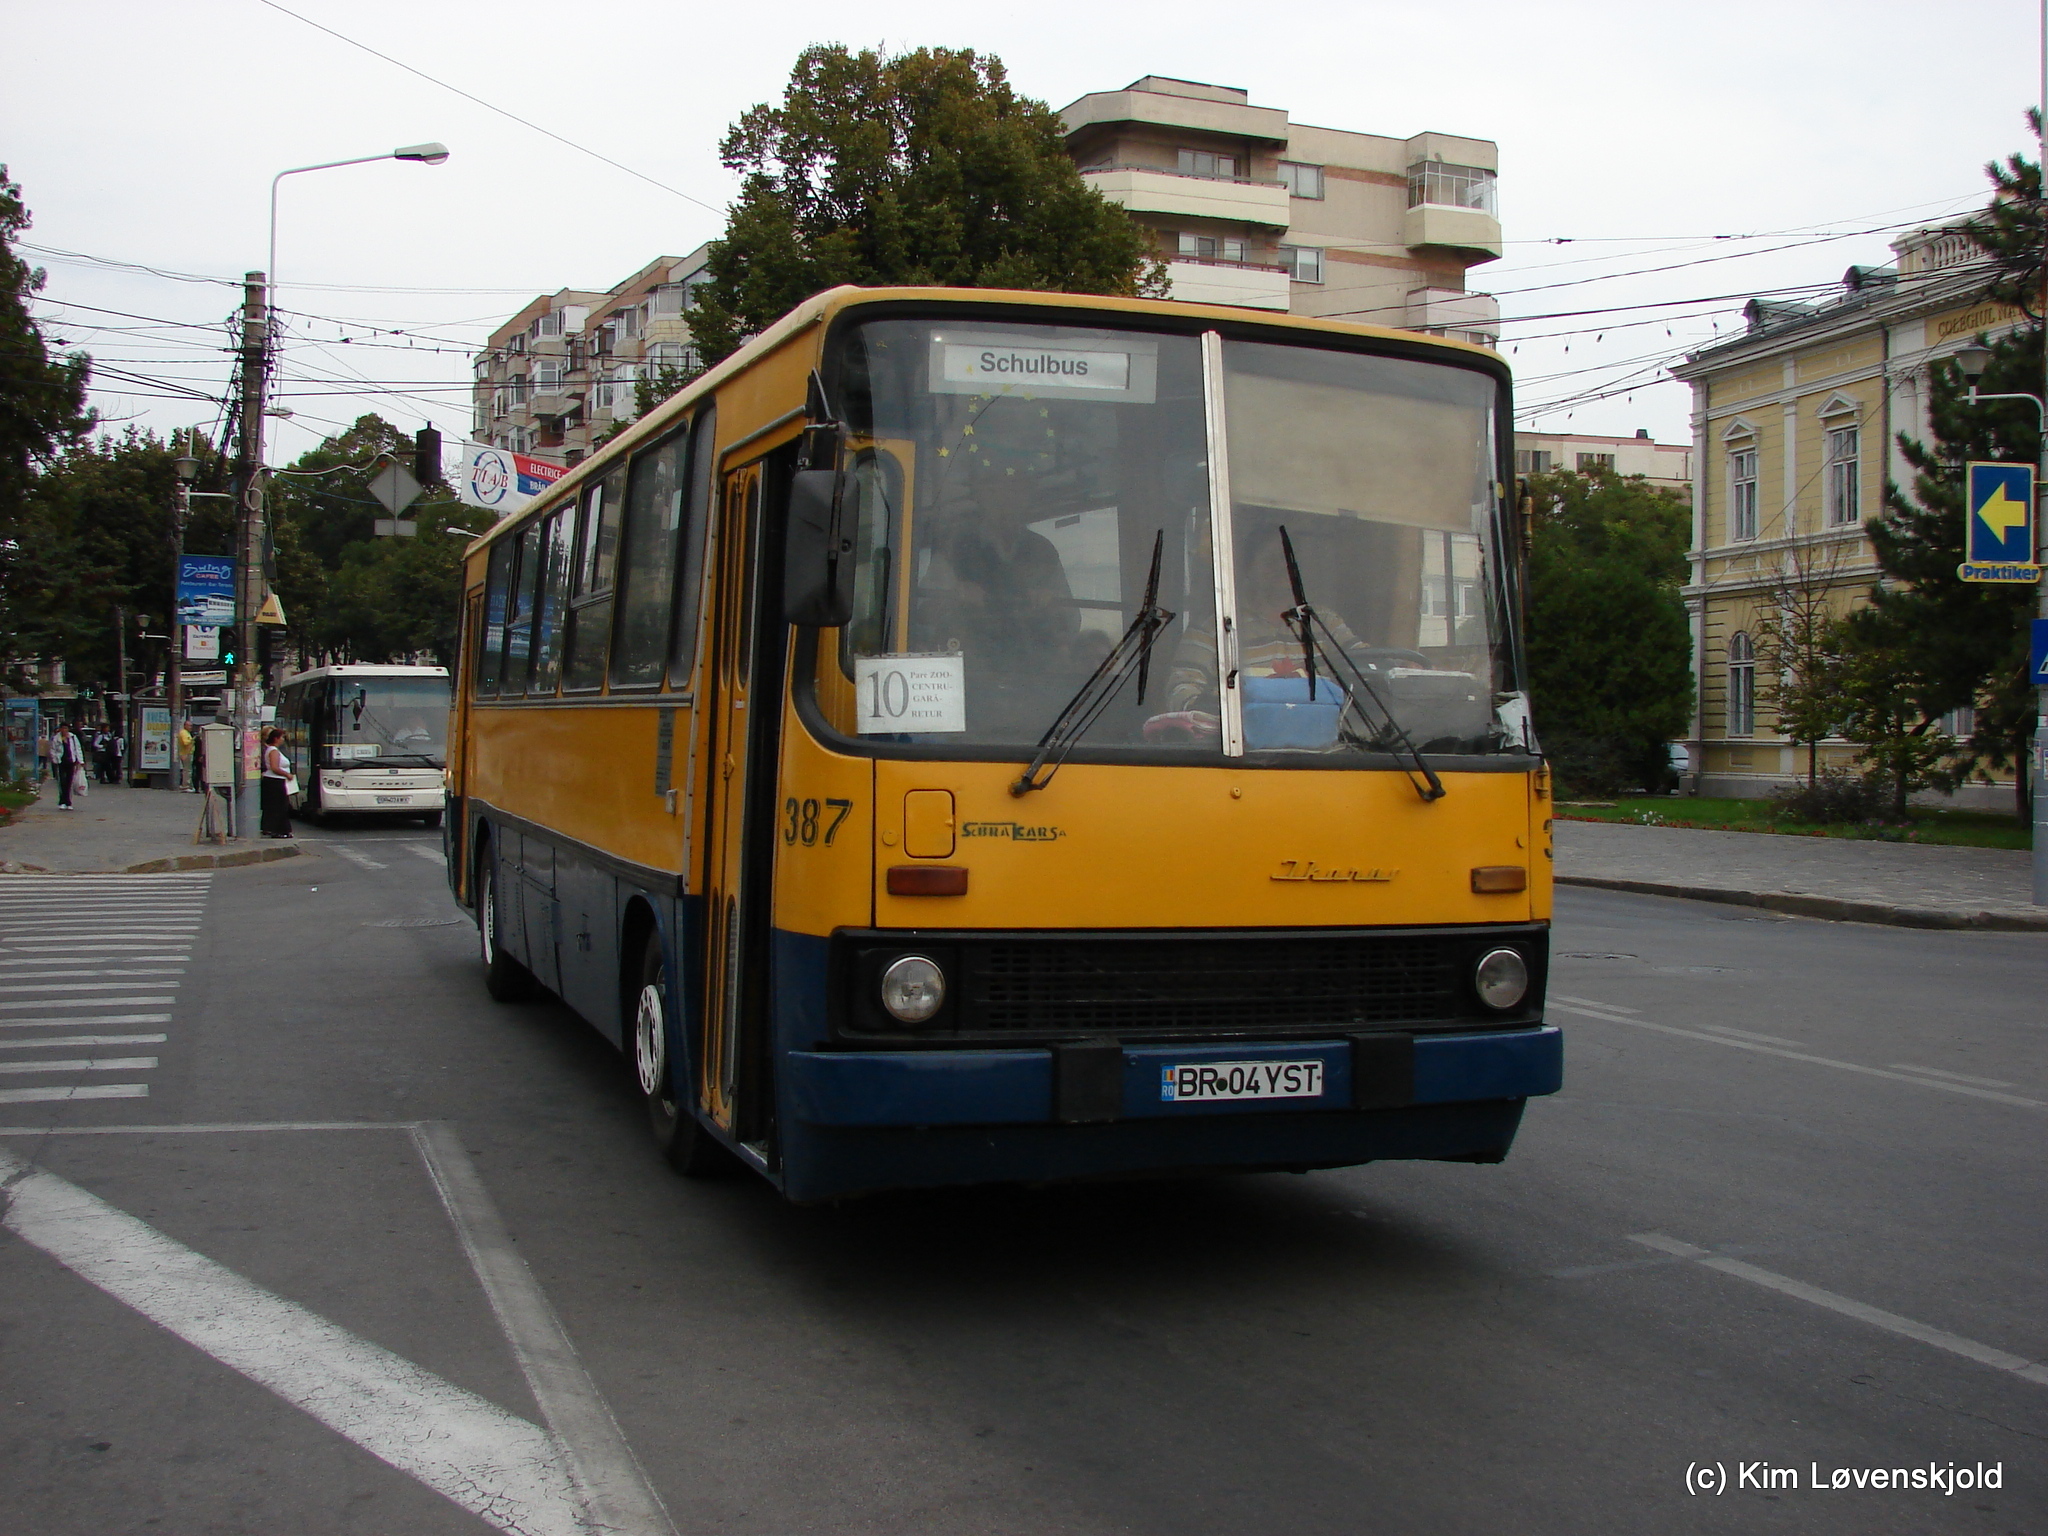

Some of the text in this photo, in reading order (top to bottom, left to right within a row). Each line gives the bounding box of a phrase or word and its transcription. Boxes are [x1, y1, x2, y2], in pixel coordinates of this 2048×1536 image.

[1938, 307, 1996, 337] COLEGIUL
[980, 352, 1089, 376] Schulbus
[471, 467, 509, 488] TIAB
[530, 463, 562, 480] ELECTRICE
[183, 562, 232, 580] Swing
[1962, 565, 2039, 581] Praktiker
[930, 671, 953, 679] ZOO-
[867, 670, 910, 718] 10
[911, 683, 953, 691] CENTRU-
[911, 710, 943, 718] RETUR
[785, 797, 853, 847] 387
[1162, 1086, 1174, 1097] RO
